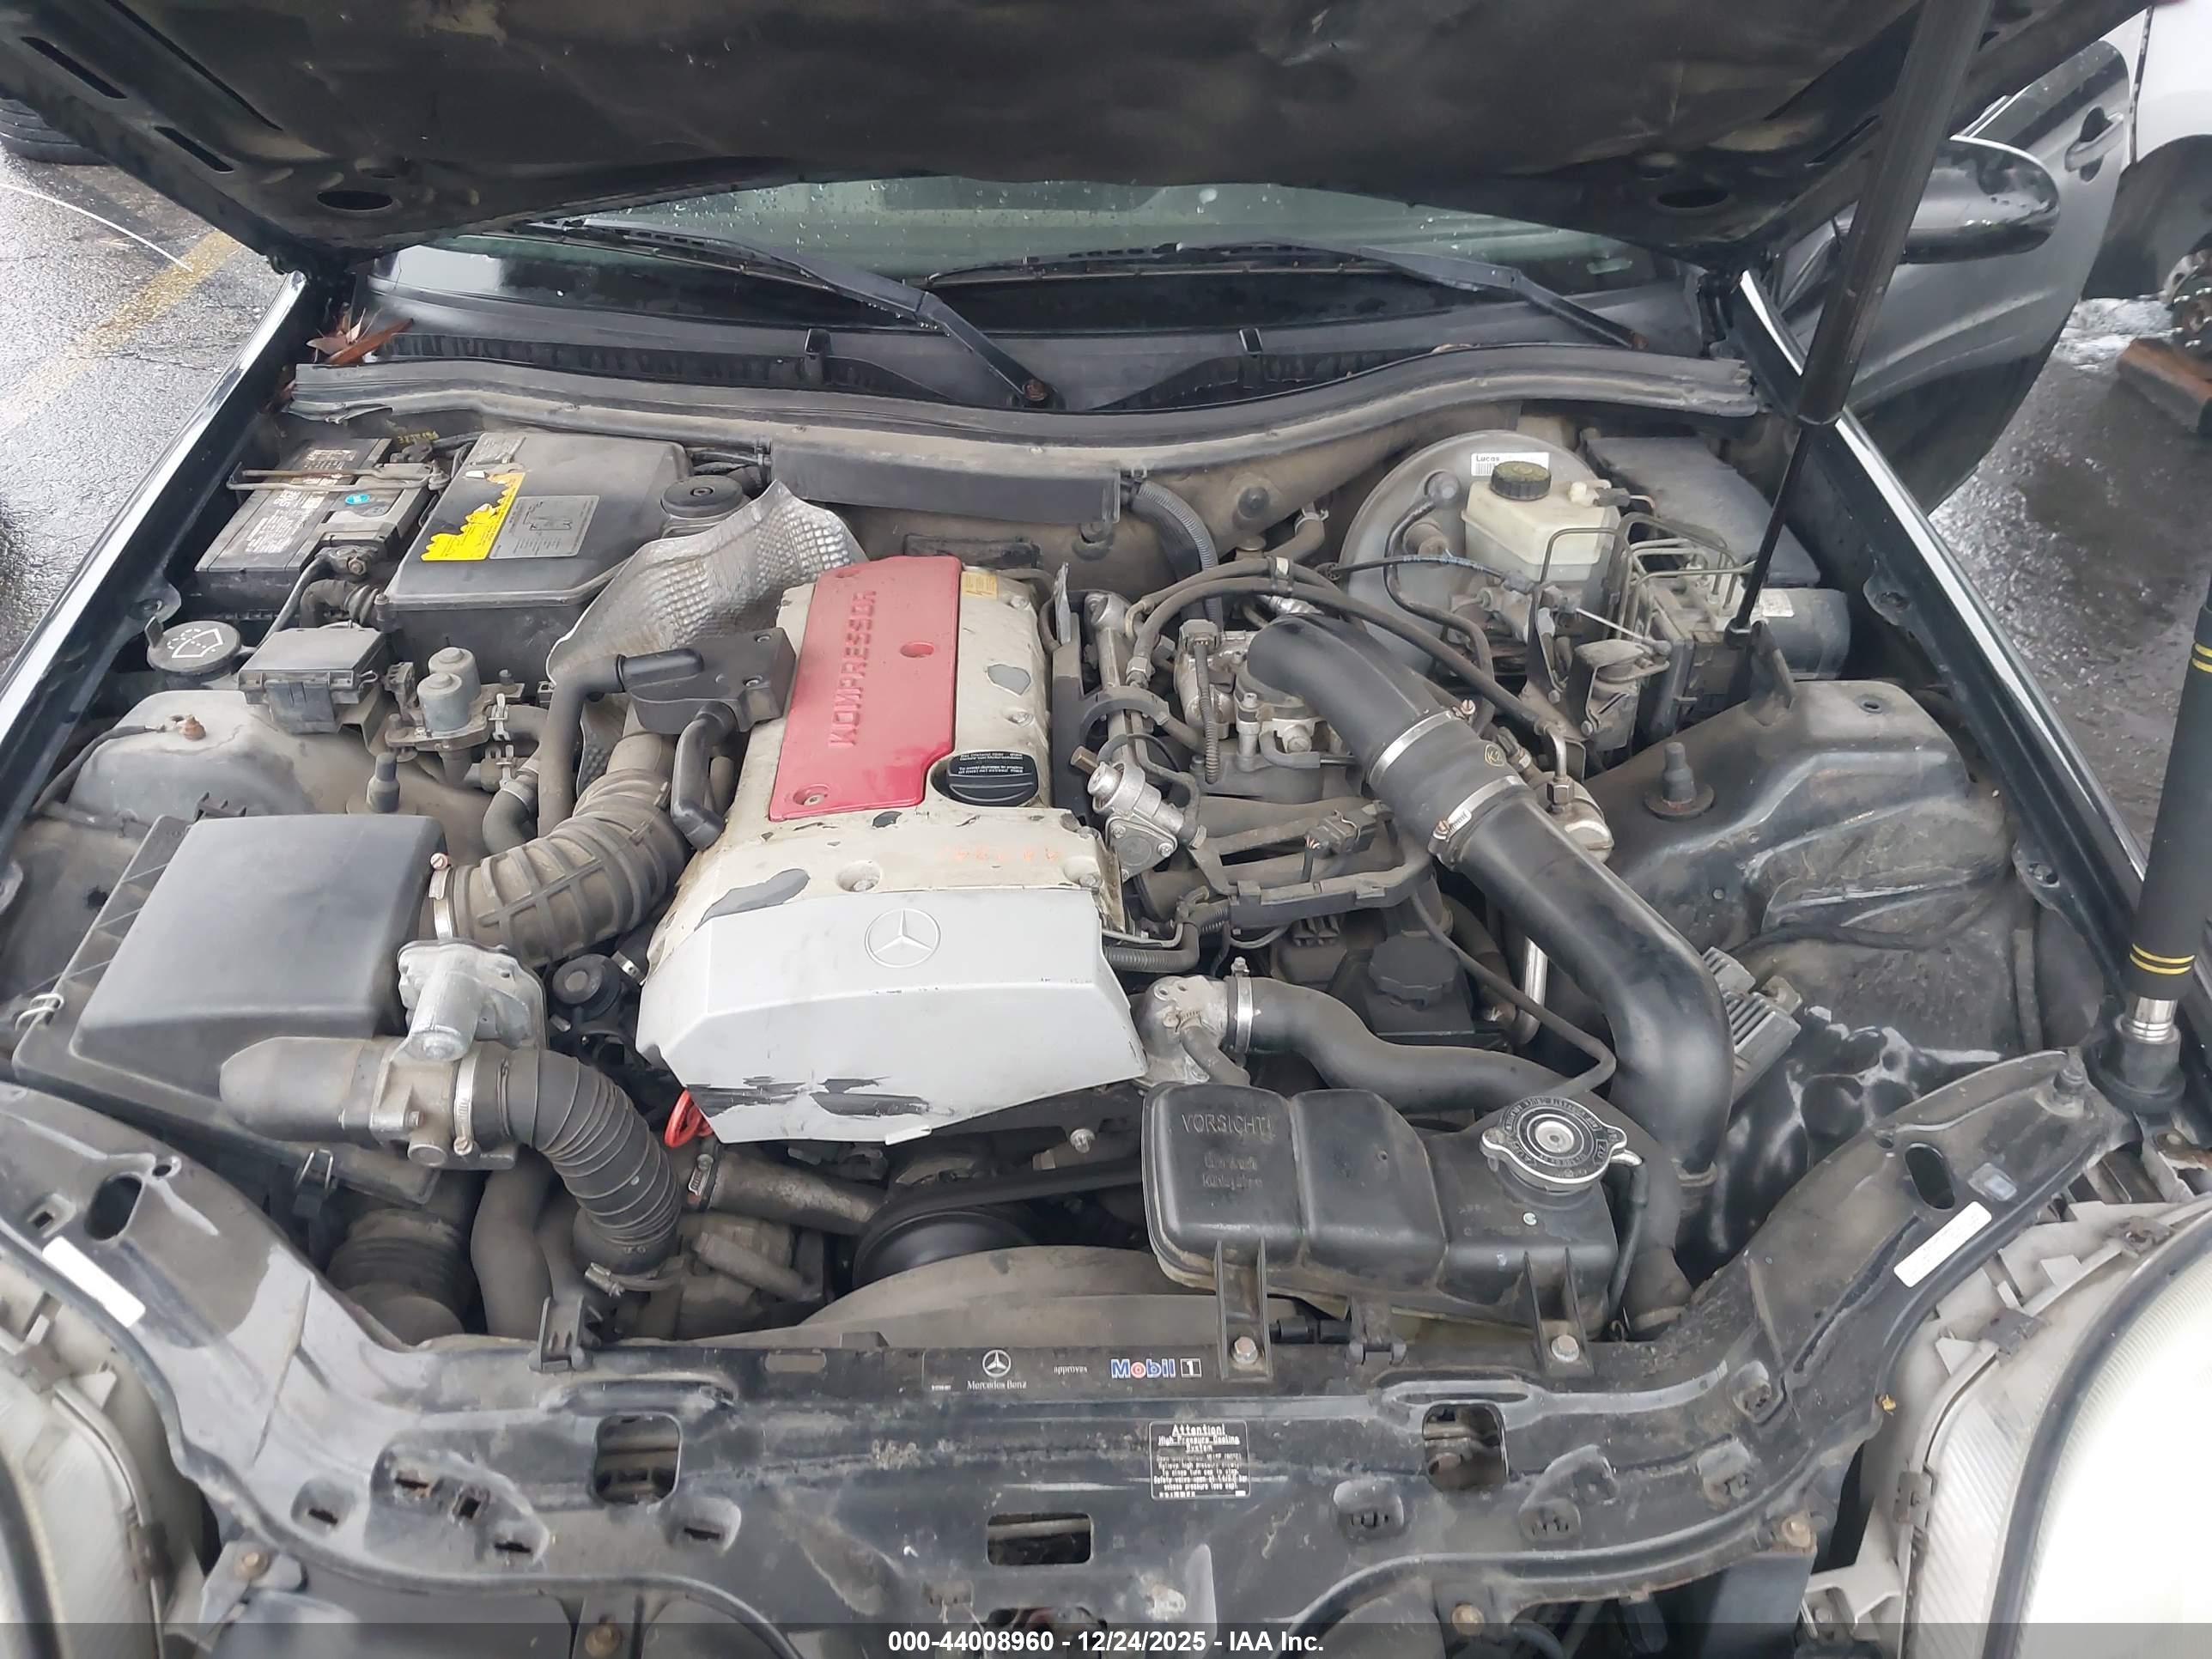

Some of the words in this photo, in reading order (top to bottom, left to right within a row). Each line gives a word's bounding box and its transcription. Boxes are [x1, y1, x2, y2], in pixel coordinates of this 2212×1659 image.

[829, 591, 877, 748] KOMPRESSOR
[1054, 1366, 1088, 1376] approves
[1110, 1358, 1176, 1379] Mobil
[967, 1380, 1006, 1390] Mercedes
[1007, 1380, 1027, 1389] Benz
[1172, 1423, 1225, 1436] Attention!
